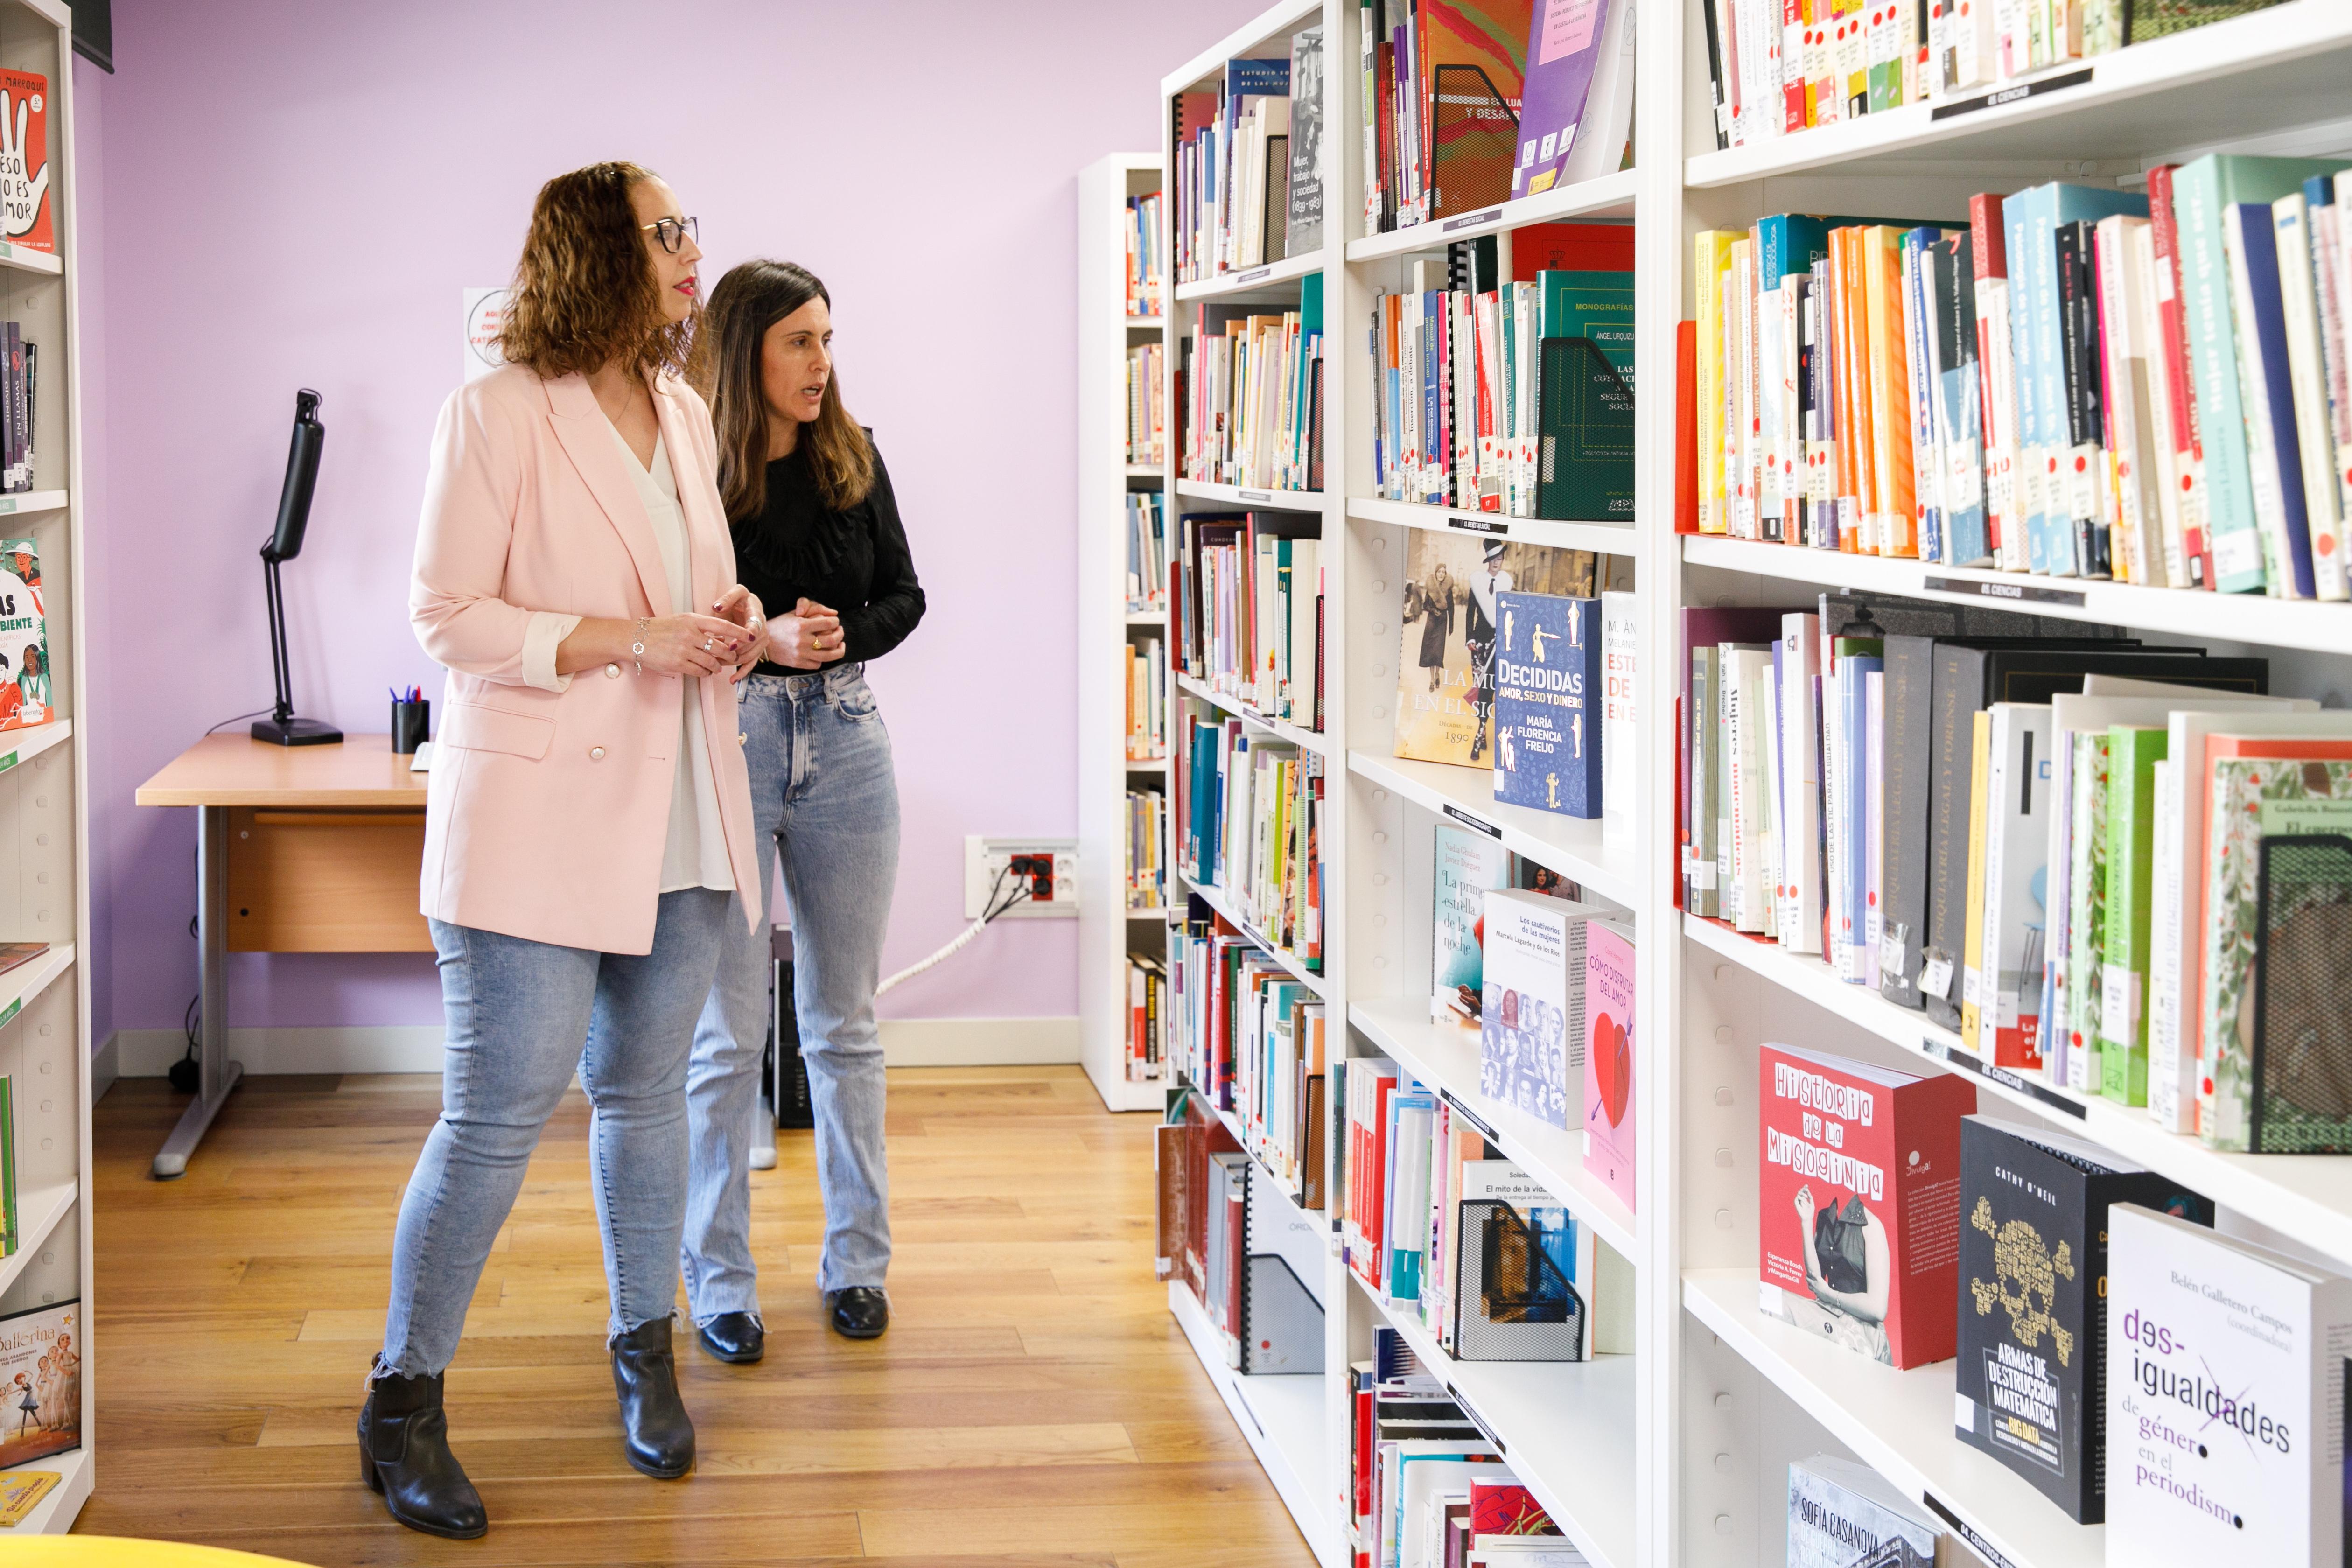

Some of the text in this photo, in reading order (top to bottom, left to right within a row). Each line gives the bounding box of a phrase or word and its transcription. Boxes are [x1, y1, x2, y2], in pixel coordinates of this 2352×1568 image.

[1293, 155, 1309, 168] Mujer,
[1293, 170, 1310, 182] trabajo
[1292, 183, 1319, 200] y sociedad
[2194, 238, 2212, 279] que
[2014, 223, 2030, 365] Psicología mujer
[2035, 217, 2051, 363] Psicología mujer
[2196, 284, 2216, 343] tenía
[1596, 331, 1612, 340] ÁNGEL
[1430, 343, 1435, 351] de
[2206, 348, 2223, 413] Mujer
[1991, 584, 2022, 598] CIENCIAS
[0, 617, 32, 631] BIENTE
[1608, 620, 1619, 633] M.
[1442, 669, 1467, 687] LA
[1498, 658, 1582, 694] DECIDIDAS
[1499, 686, 1583, 709] AMOR, SEXO Y DINERO
[1609, 676, 1630, 699] DE
[1414, 693, 1466, 715] EN EL
[1608, 703, 1624, 720] EN
[1526, 714, 1553, 729] MARÍA
[1943, 689, 1956, 763] FORENSE
[1517, 726, 1562, 743] FLORENCIA
[1526, 739, 1554, 754] FREIJO
[1729, 689, 1742, 876] Mujeres matemáticas
[1939, 787, 1953, 837] LEGAL
[1445, 841, 1481, 860] Nadia Ghulam
[1828, 839, 1834, 853] DE
[1444, 855, 1481, 873] Javier Diéguez
[1442, 870, 1457, 889] La
[1443, 912, 1467, 933] de la
[1520, 916, 1560, 935] Los cautiverios
[1496, 930, 1513, 941] Marcela
[1514, 936, 1532, 947] Lagarde
[1521, 925, 1528, 934] de
[1539, 933, 1560, 945] mujeres
[1443, 937, 1471, 956] noche
[1590, 954, 1608, 977] CÓMO
[1610, 966, 1633, 997] DISFRUTAR
[1600, 980, 1626, 1010] DEL AMOR
[1981, 1064, 2023, 1090] 05. CIENCIAS
[1804, 1113, 1821, 1139] de
[1995, 1166, 2056, 1206] CATHY O'NEIL
[1767, 1252, 1803, 1271] Esperanza Bosch,
[1767, 1259, 1784, 1270] Victoria
[1789, 1268, 1802, 1277] Ferrer
[1771, 1268, 1792, 1281] Margarita
[2171, 1270, 2292, 1335] Belén Galletero Campos
[2227, 1313, 2292, 1355] (coordinadora)
[10, 1349, 37, 1360] ABANDONES
[1998, 1342, 2047, 1380] ARMAS DE
[1988, 1360, 2057, 1408] DESTRUCCIÓN
[1993, 1384, 2056, 1432] MATEMÁTICA
[2121, 1395, 2139, 1416] de
[2134, 1348, 2290, 1454] igualdades
[2008, 1415, 2022, 1435] BIG
[2022, 1421, 2040, 1446] DATA
[2138, 1445, 2172, 1470] en el
[1801, 1497, 1879, 1561] SOFÍA CASANOVA
[1960, 1524, 1970, 1539] 04.
